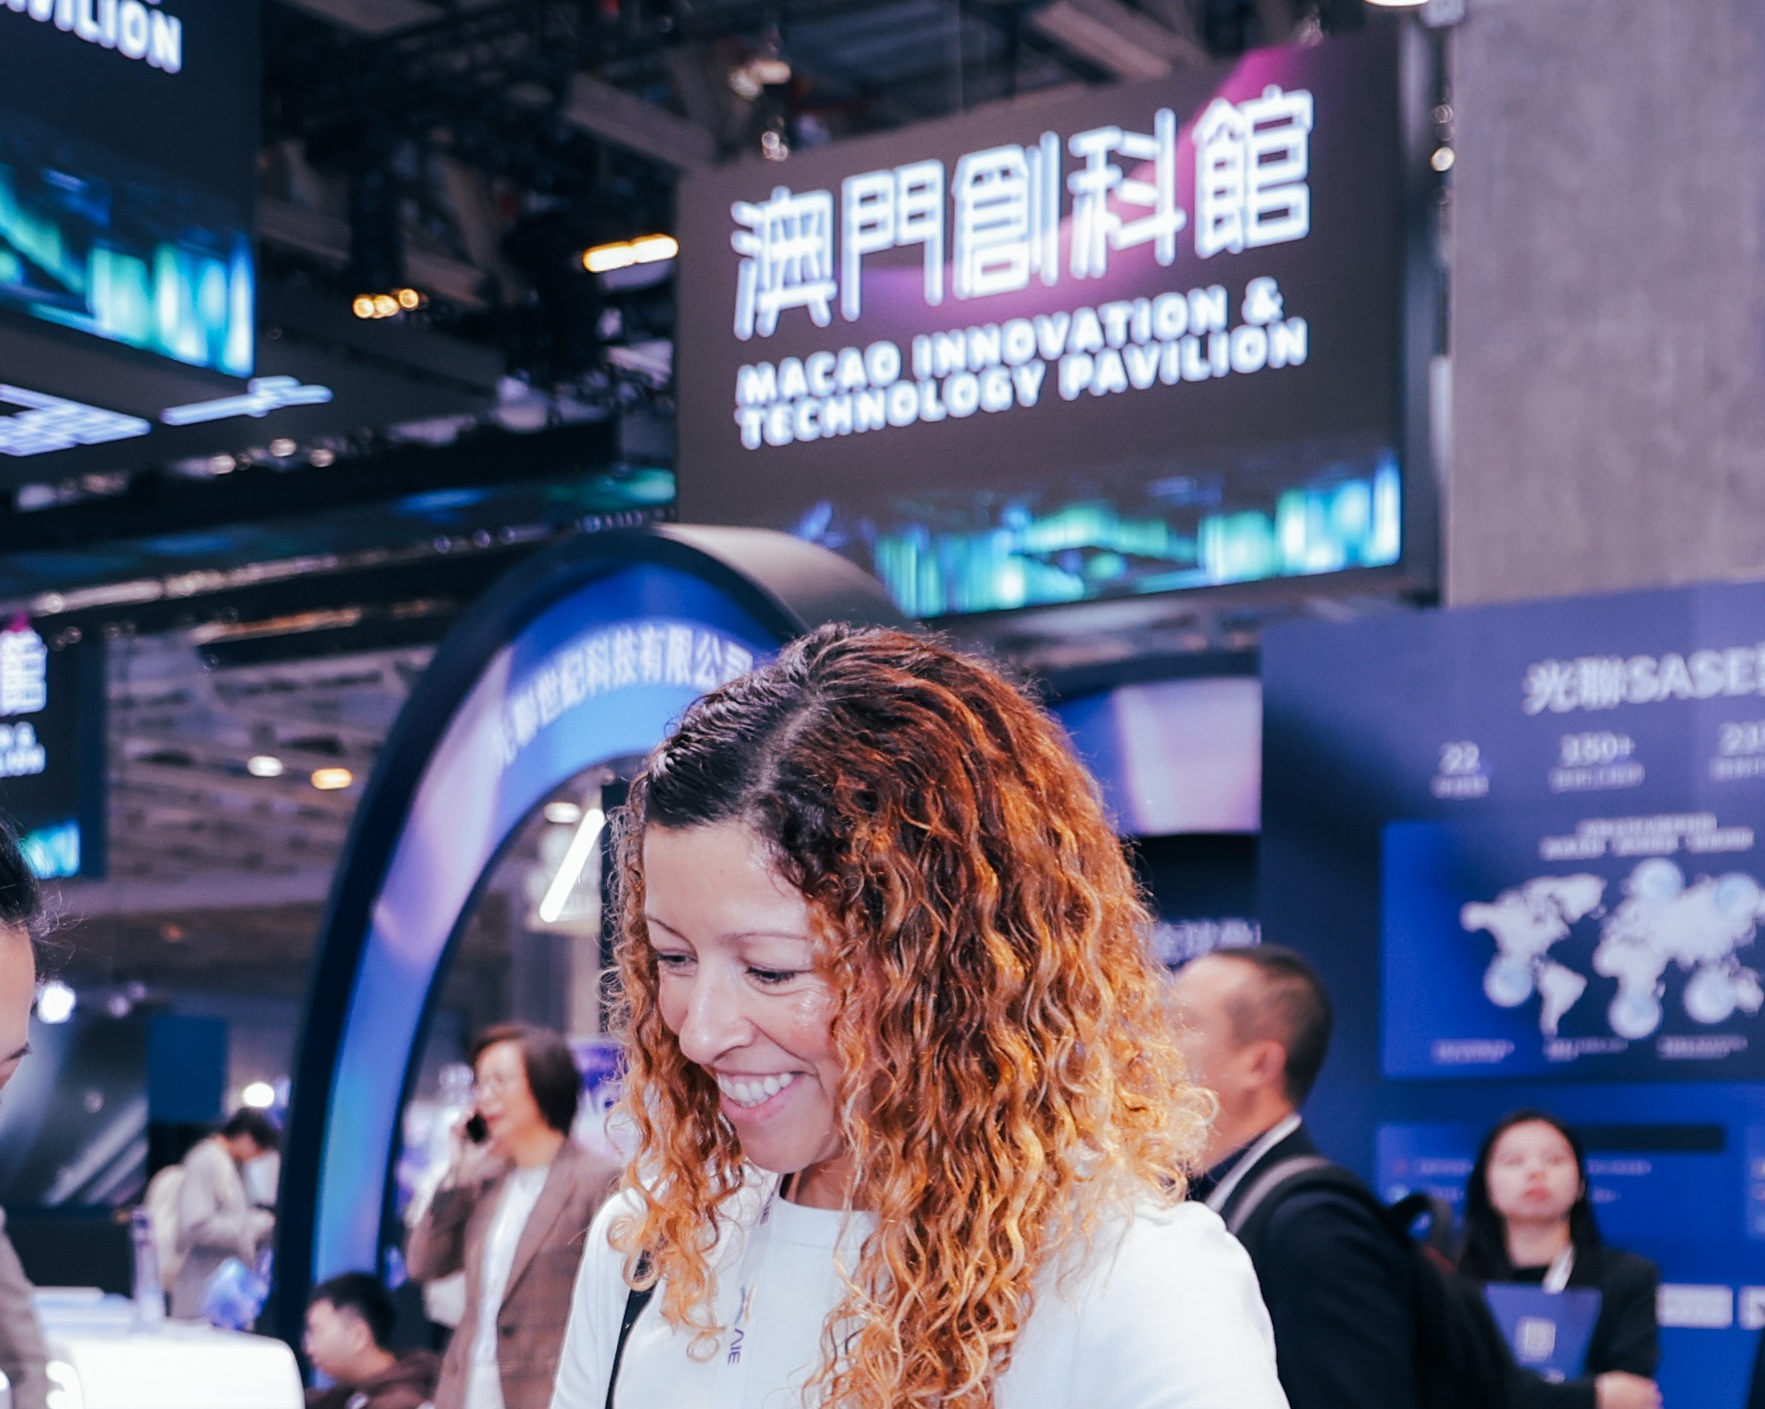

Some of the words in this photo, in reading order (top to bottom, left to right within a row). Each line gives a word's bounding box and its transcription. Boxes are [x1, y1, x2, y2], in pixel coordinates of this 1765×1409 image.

[730, 84, 1313, 341] 澳門創科館
[735, 341, 903, 406] MACAO
[911, 283, 1228, 380] INNOVATION
[1241, 276, 1283, 326] &
[735, 360, 1046, 450] TECHNOLOGY
[1058, 318, 1308, 400] PAVILION
